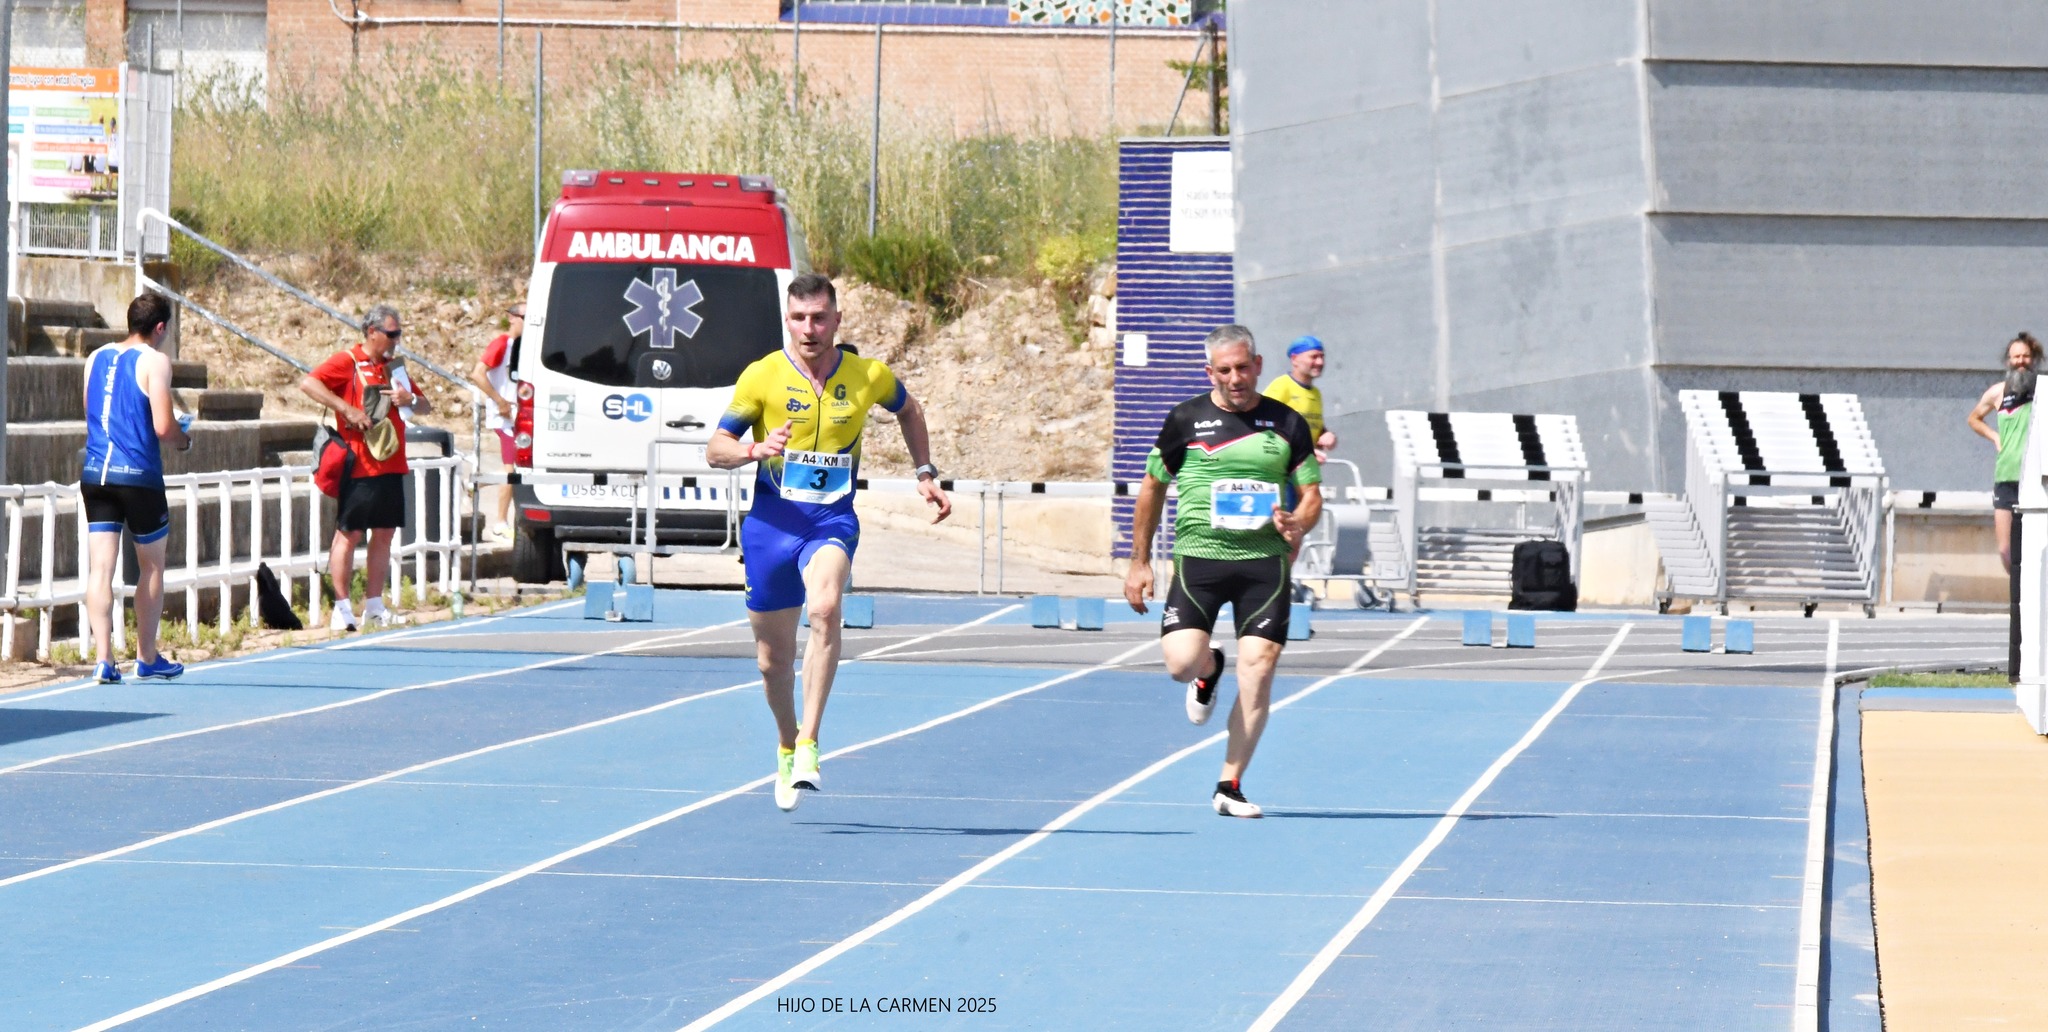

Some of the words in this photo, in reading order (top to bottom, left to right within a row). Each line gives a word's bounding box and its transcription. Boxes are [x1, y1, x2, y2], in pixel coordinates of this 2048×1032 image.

[568, 231, 756, 263] AMBULANCIA
[605, 398, 651, 417] SHL
[549, 422, 575, 431] DEA
[802, 453, 838, 467] A4XKM
[809, 468, 829, 490] 3
[1239, 495, 1255, 513] 2
